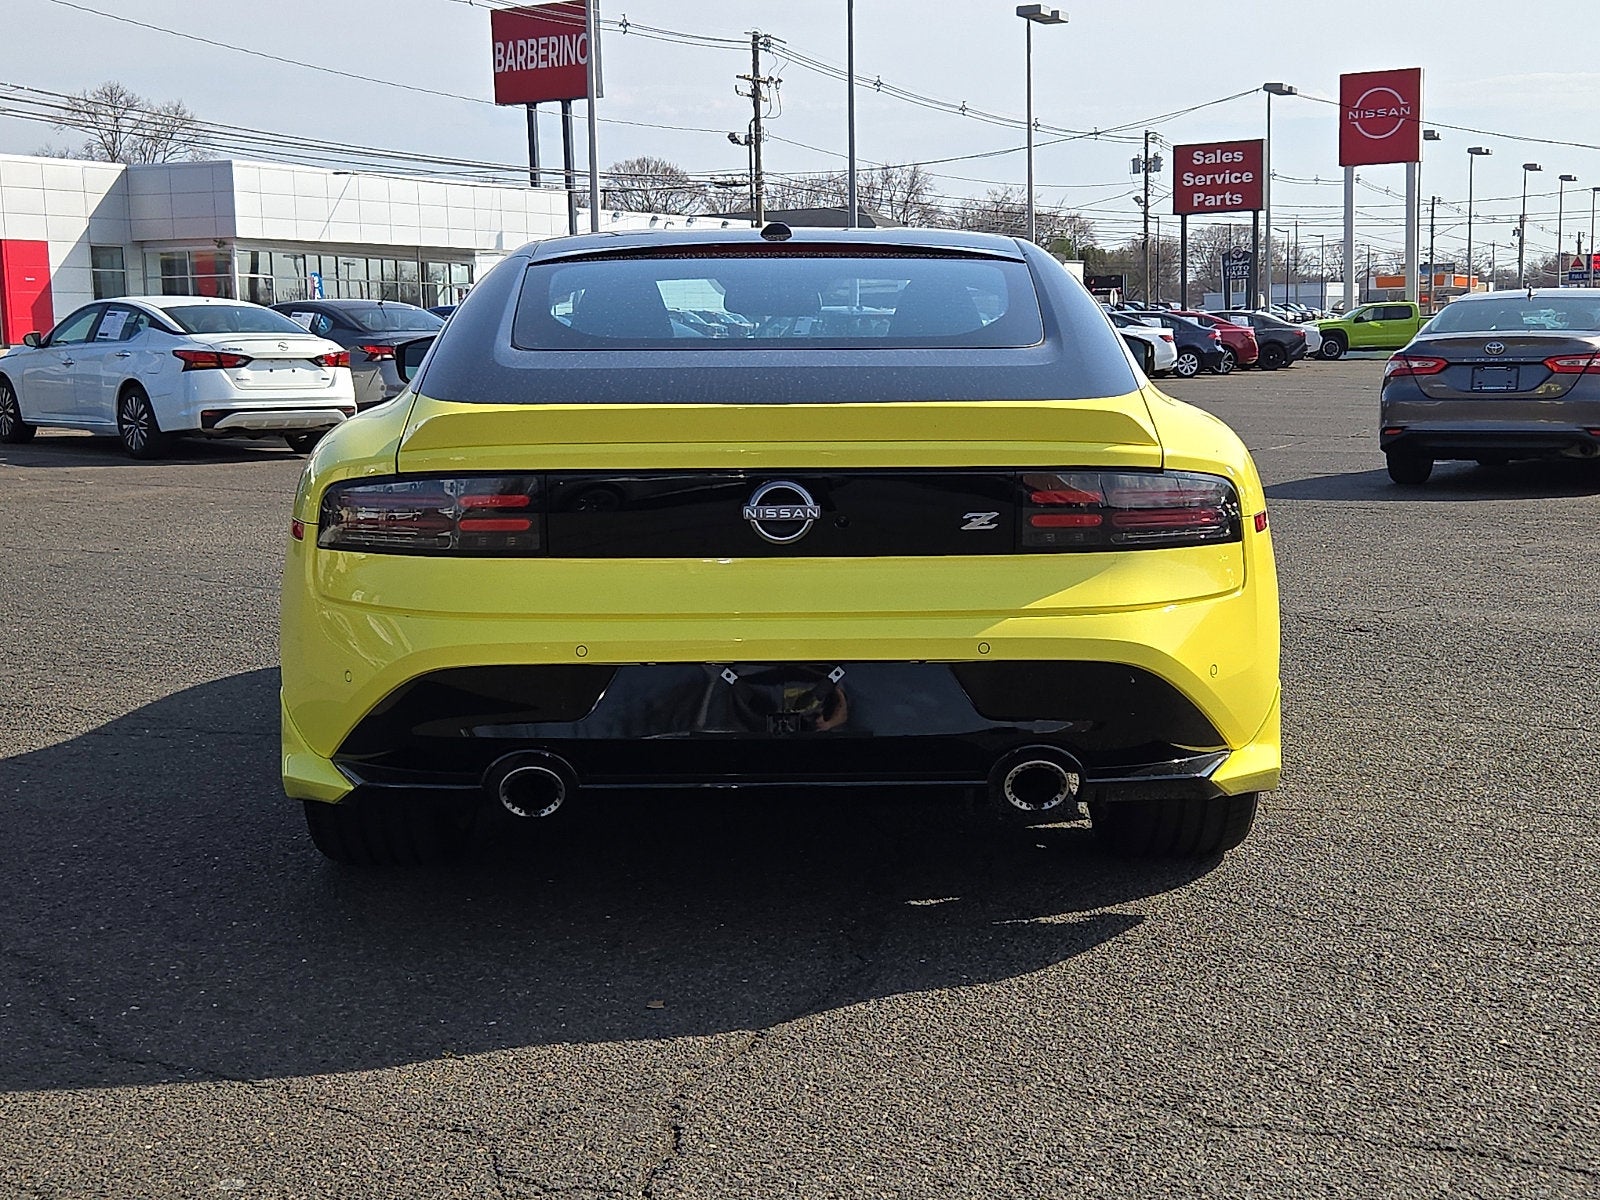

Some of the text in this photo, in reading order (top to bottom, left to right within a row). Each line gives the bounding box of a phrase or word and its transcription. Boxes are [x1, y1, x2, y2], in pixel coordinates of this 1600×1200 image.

[494, 32, 588, 73] BARBERINO
[1348, 106, 1411, 120] NISSAN
[1192, 150, 1244, 165] Sales
[1182, 170, 1254, 186] Service
[1192, 191, 1243, 207] Parts
[744, 506, 819, 519] NISSAN
